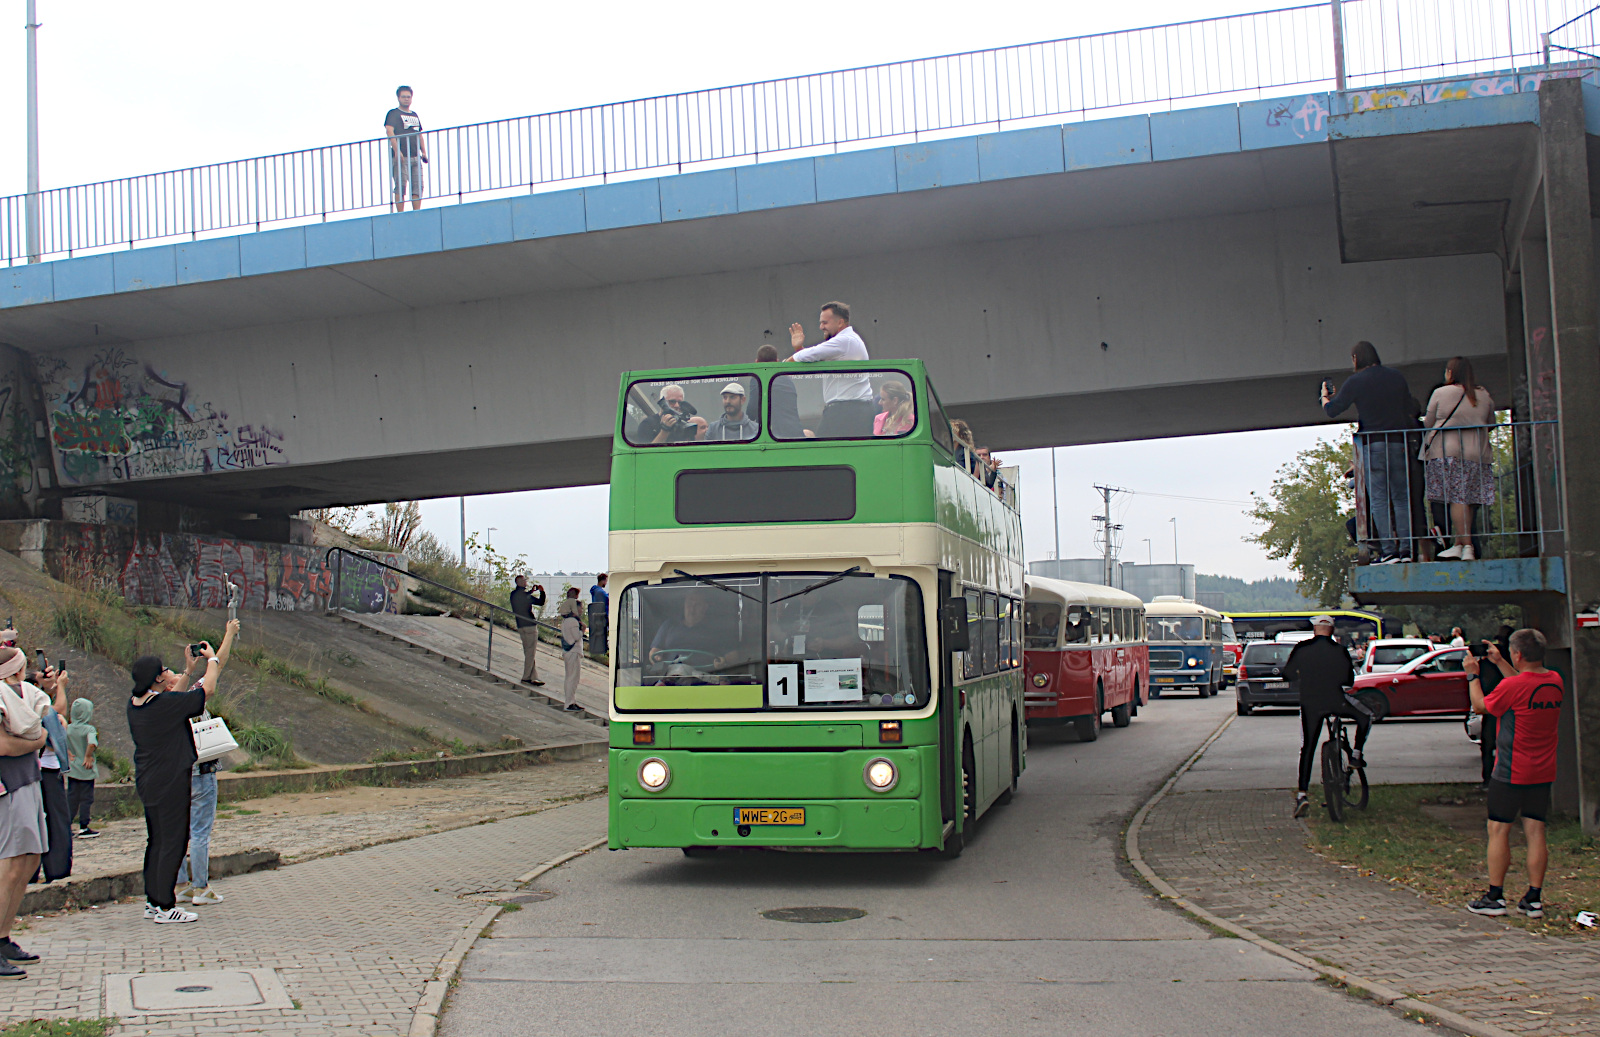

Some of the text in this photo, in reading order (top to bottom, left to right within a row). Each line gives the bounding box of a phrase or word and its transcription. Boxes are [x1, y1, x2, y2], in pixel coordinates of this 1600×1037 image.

[777, 677, 788, 696] 1
[1533, 701, 1563, 710] MAN
[742, 810, 788, 823] WWE 2G
